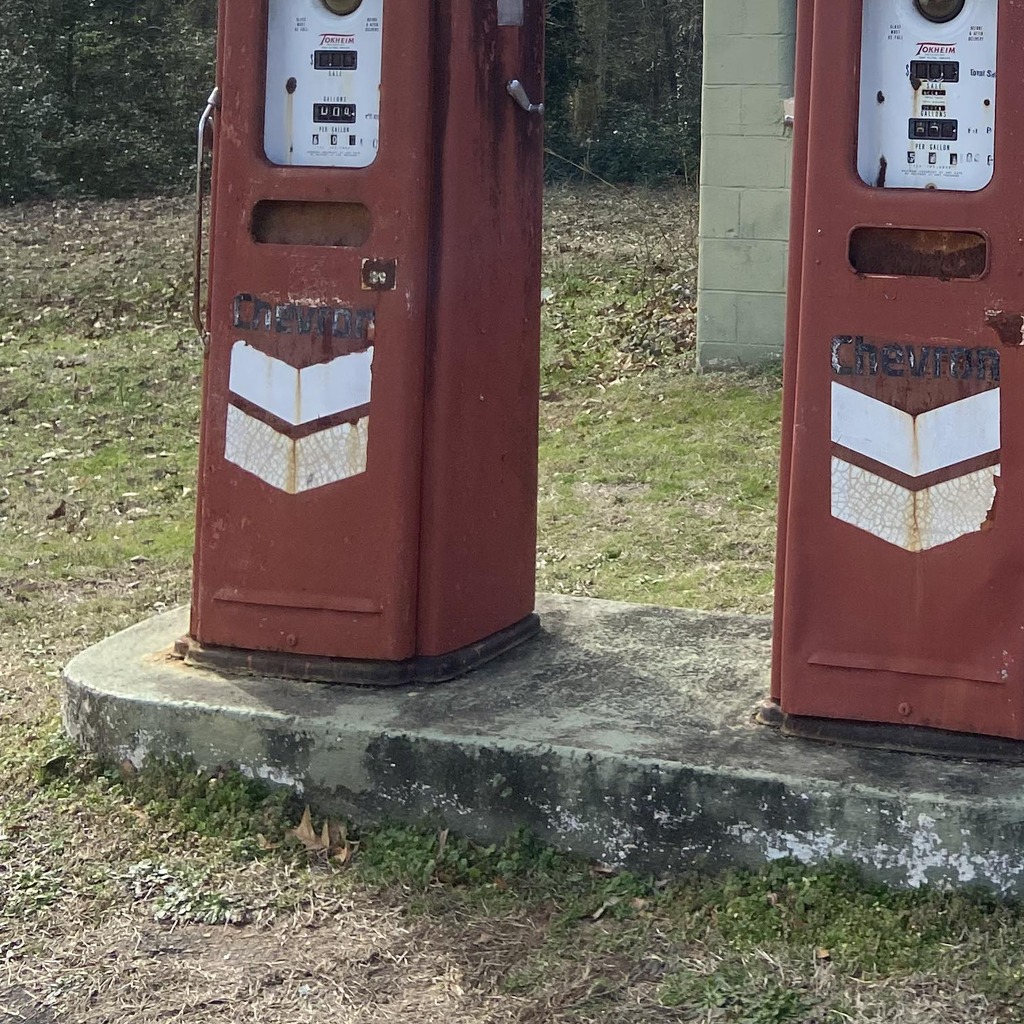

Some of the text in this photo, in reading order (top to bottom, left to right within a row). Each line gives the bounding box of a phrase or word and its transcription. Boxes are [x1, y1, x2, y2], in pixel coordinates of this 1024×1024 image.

[318, 33, 356, 46] TOKHEIM
[915, 42, 957, 57] TOKHEIM
[929, 143, 951, 151] GALLON
[831, 335, 1000, 380] Chevron
